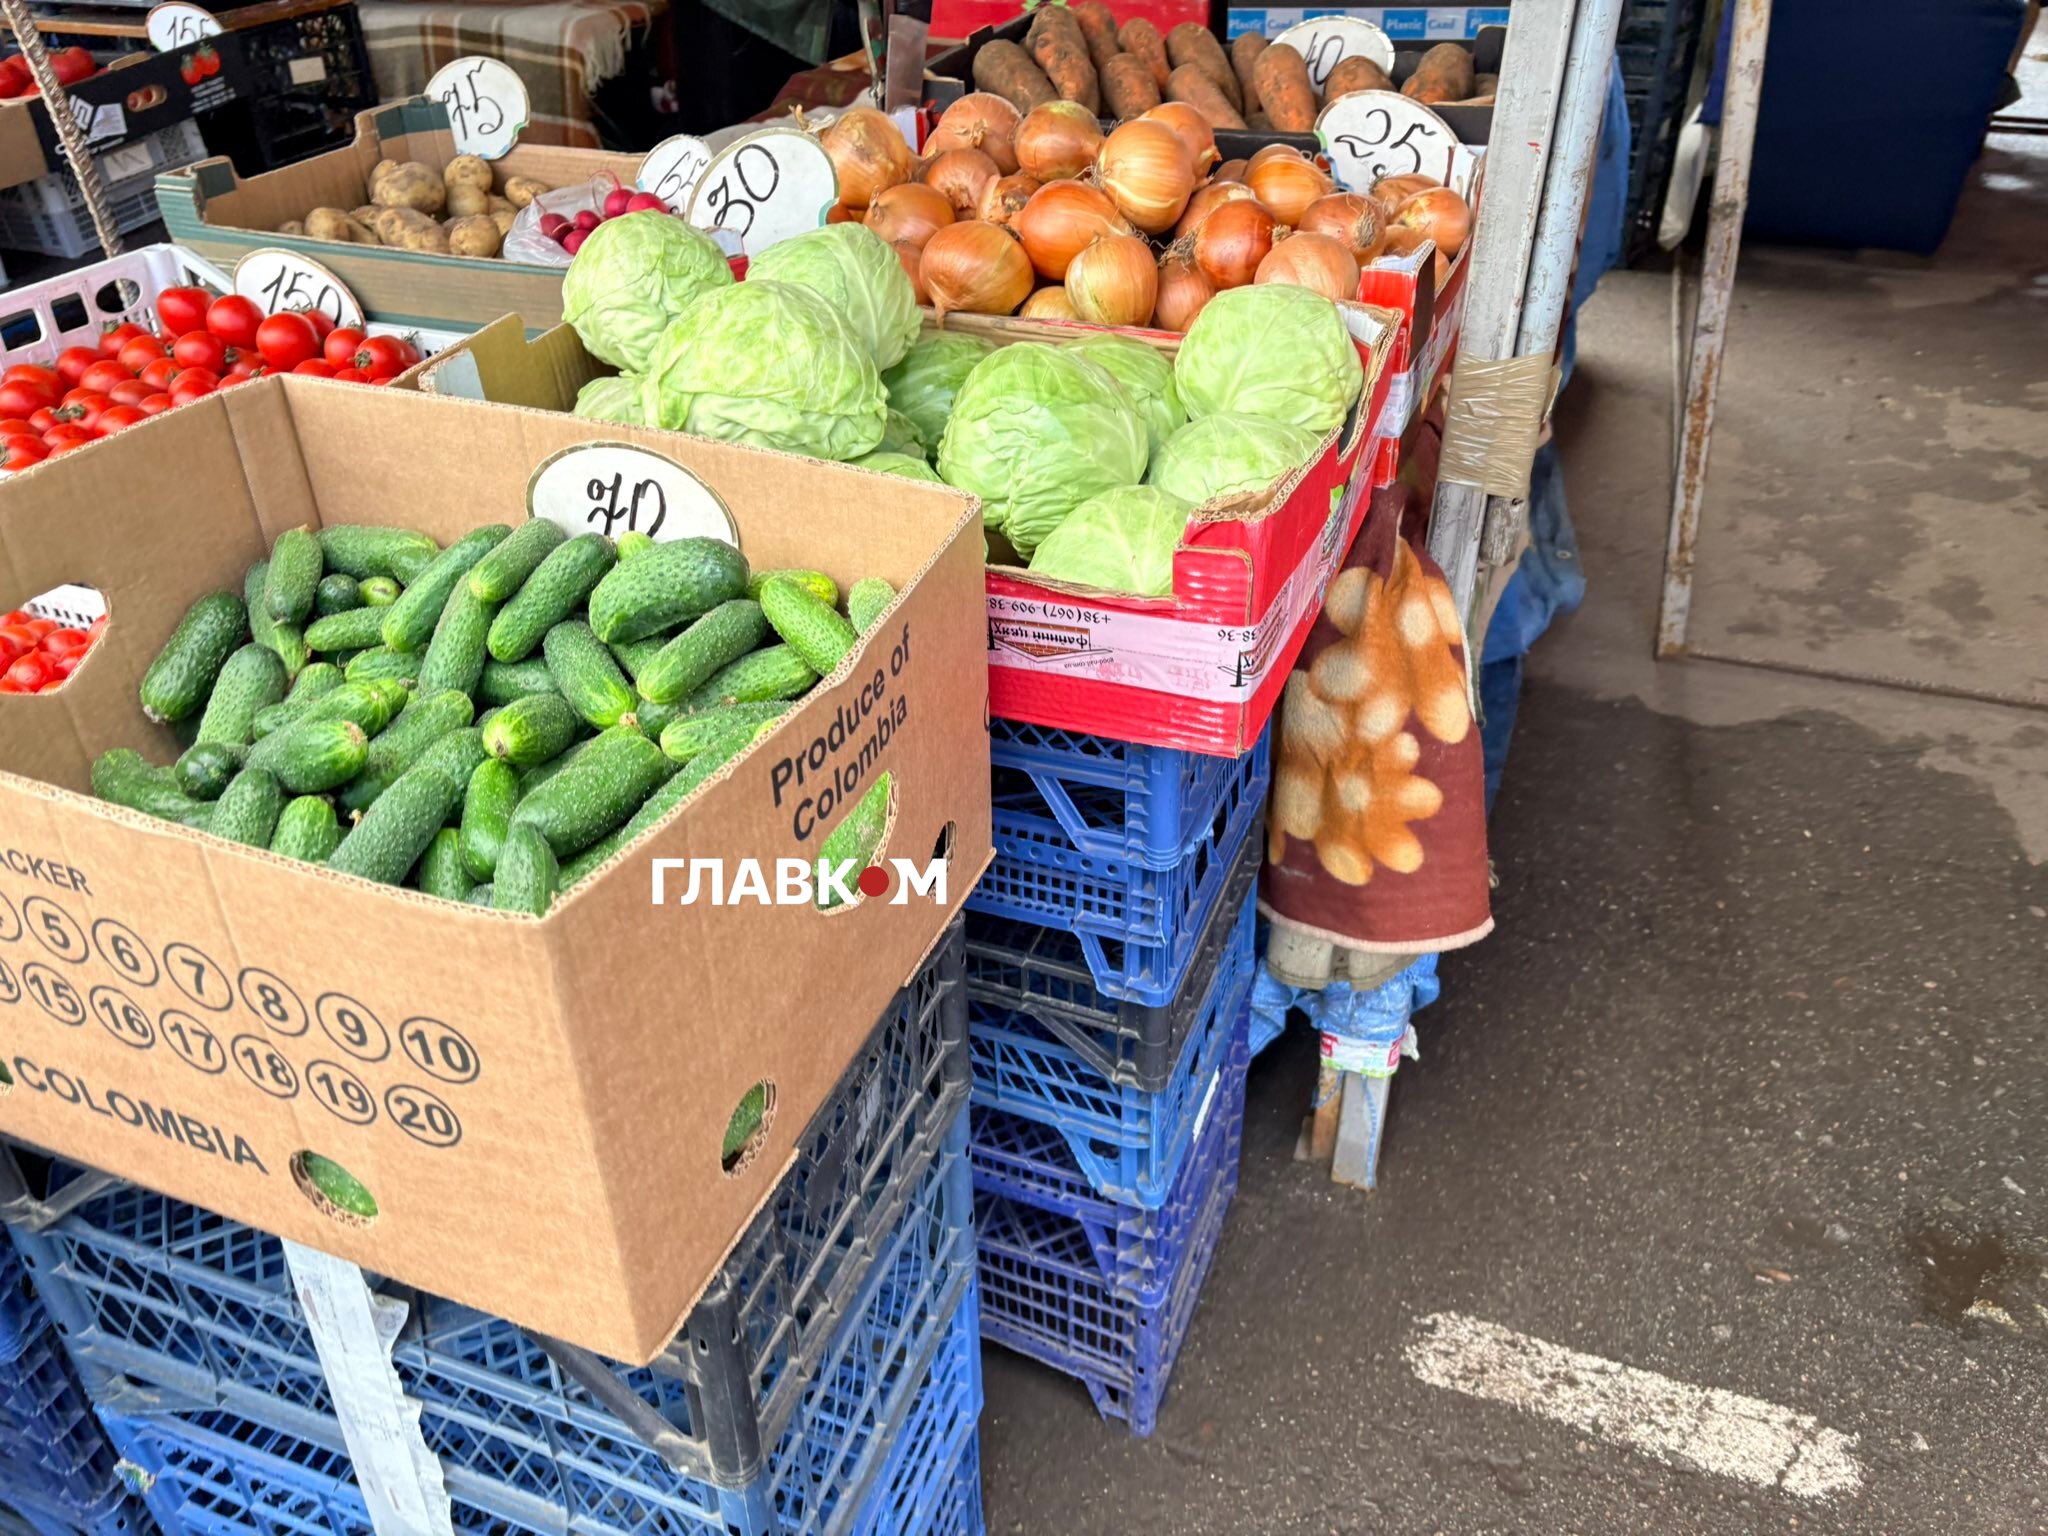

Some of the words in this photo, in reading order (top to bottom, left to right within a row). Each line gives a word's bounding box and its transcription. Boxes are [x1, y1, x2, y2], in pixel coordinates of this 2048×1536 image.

[1386, 18, 1423, 30] Plastic
[442, 59, 503, 141] 75
[707, 144, 779, 238] 30
[261, 265, 343, 327] 150
[587, 472, 667, 537] 70
[770, 668, 885, 808] Produce
[890, 621, 911, 678] of
[792, 694, 907, 842] Colombia
[41, 911, 71, 950] 5
[111, 935, 141, 973] 6
[180, 955, 205, 997] 7
[257, 983, 289, 1022] 8
[336, 1008, 367, 1046] 9
[407, 1028, 471, 1073] 10
[29, 973, 80, 1016] 15
[99, 997, 149, 1038] 16
[169, 1022, 213, 1062] 17
[242, 1047, 293, 1089] 18
[316, 1072, 369, 1114] 19
[394, 1095, 453, 1136] 20
[13, 1056, 269, 1175] COLOMBIA
